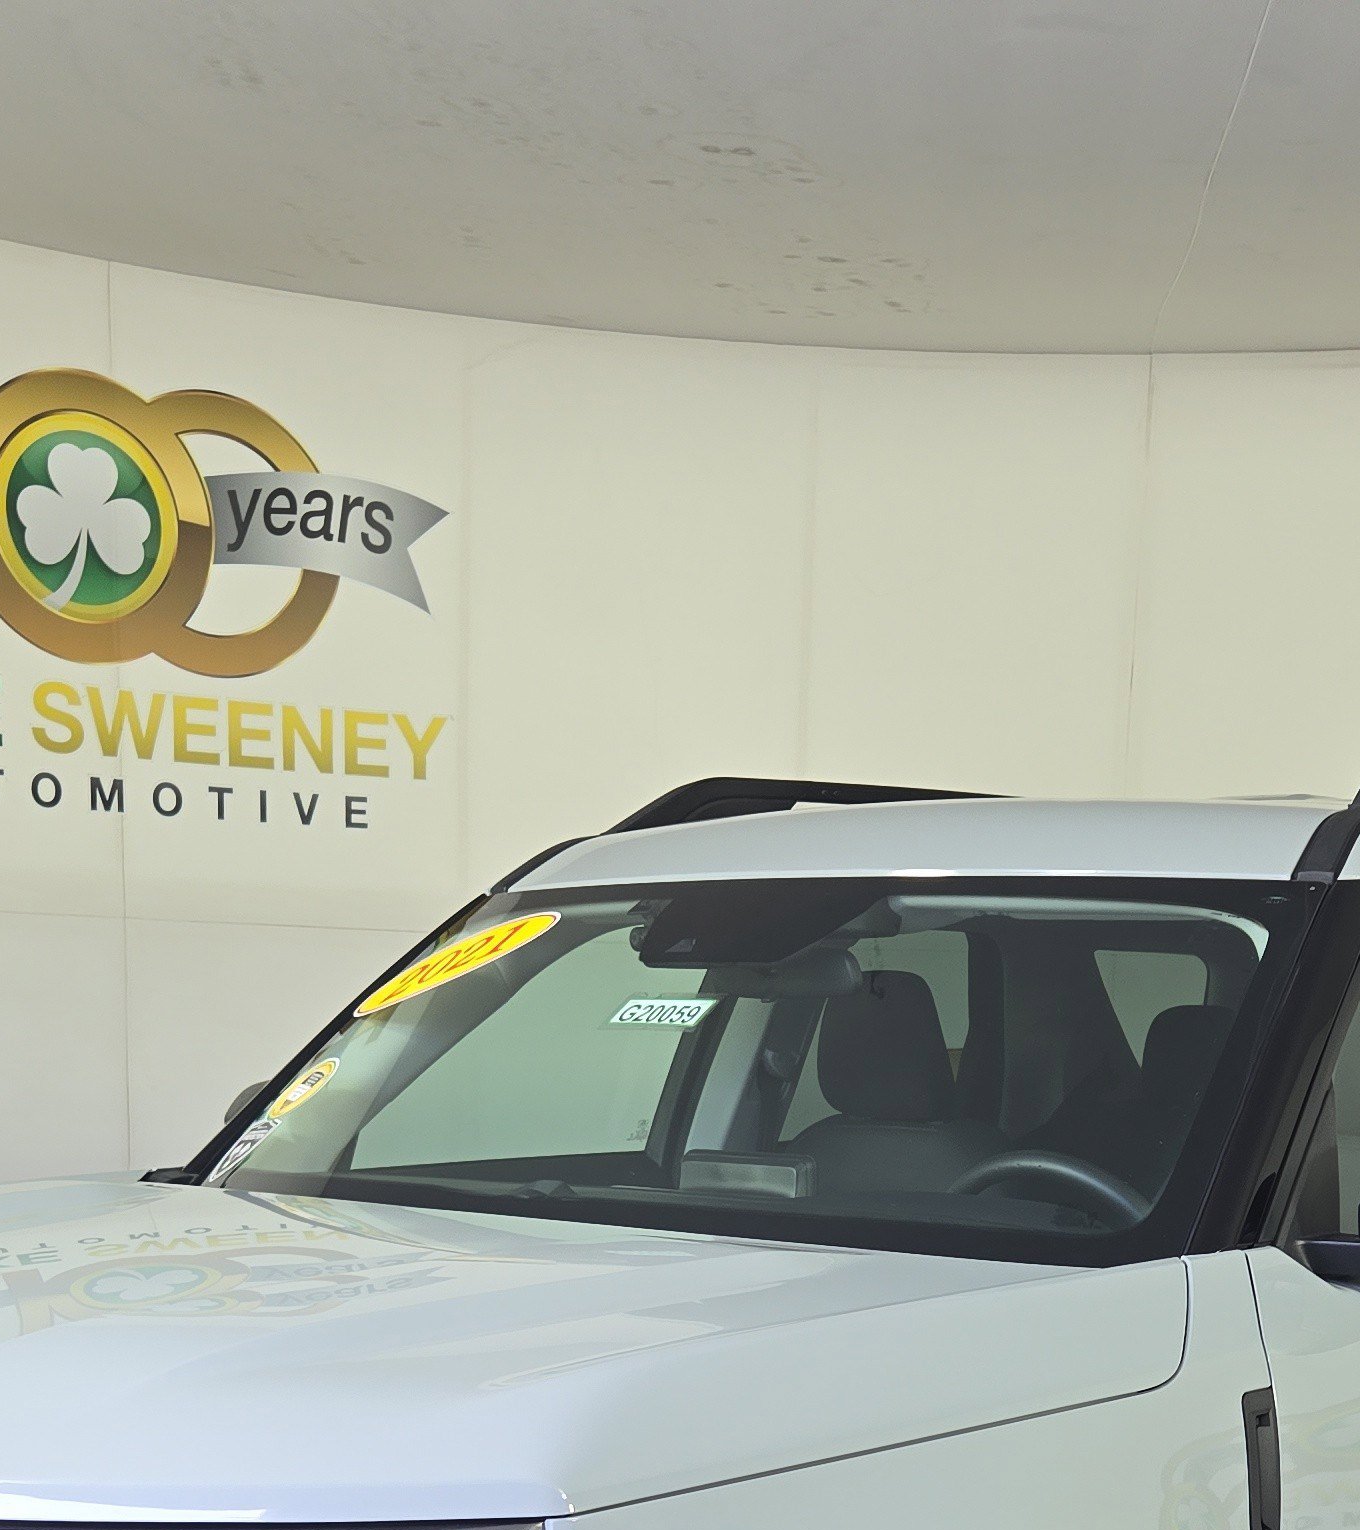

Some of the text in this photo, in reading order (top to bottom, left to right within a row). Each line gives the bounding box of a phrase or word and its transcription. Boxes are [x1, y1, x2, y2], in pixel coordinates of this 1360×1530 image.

[226, 485, 395, 555] years
[31, 680, 448, 781] SWEENEY
[380, 920, 530, 1004] 2021
[618, 1003, 702, 1024] G20059
